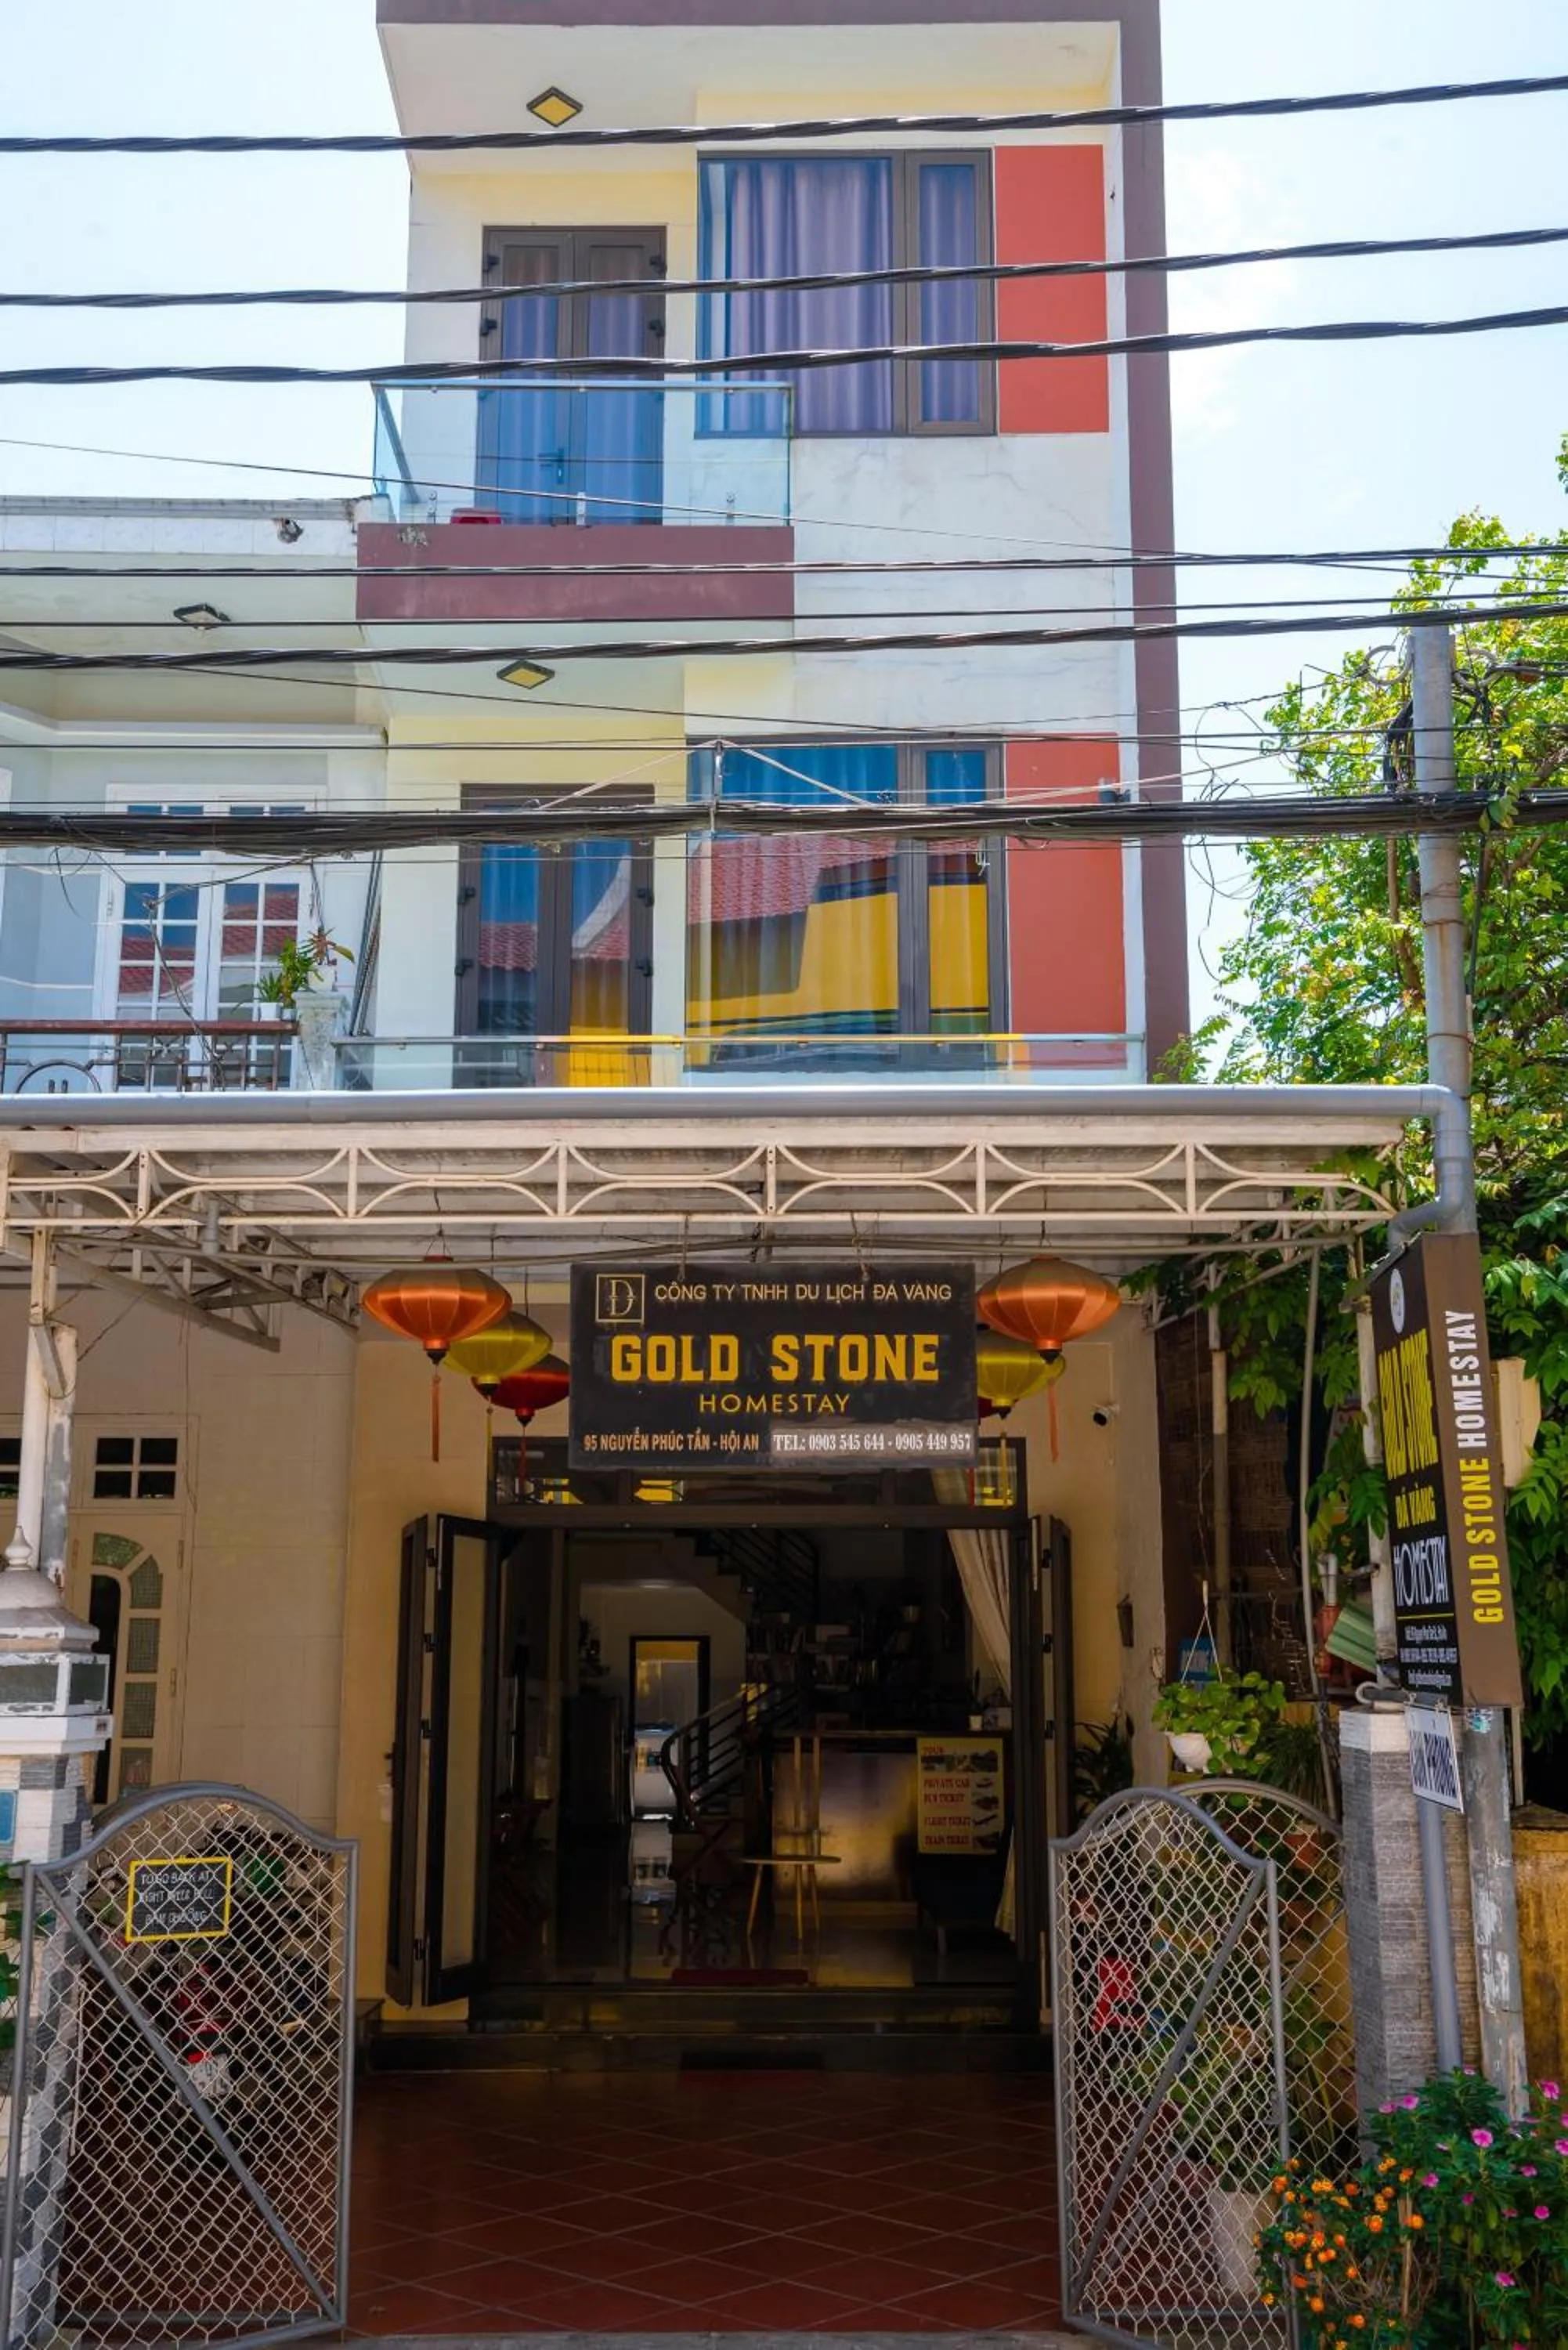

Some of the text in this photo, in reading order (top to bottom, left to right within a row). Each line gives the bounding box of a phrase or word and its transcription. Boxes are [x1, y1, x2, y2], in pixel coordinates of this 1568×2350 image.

[655, 1281, 706, 1300] CÔNG
[712, 1284, 735, 1300] TY
[741, 1284, 787, 1300] TNHH
[795, 1284, 818, 1300] DU
[826, 1284, 865, 1304] LỊCH
[611, 1335, 939, 1382] GOLD STONE
[699, 1394, 850, 1413] HOMESTAY
[583, 1434, 599, 1451] 95
[652, 1430, 684, 1452] PHÚC
[742, 1434, 759, 1452] AN
[774, 1434, 805, 1452] TEL:
[809, 1434, 836, 1452] 0903
[840, 1434, 861, 1452] 545
[864, 1434, 884, 1452] 644
[895, 1434, 923, 1451] 0905
[927, 1434, 947, 1451] 449
[950, 1434, 971, 1451] 957
[1445, 1310, 1505, 1623] GOLD STONE HOMESTAY
[139, 1890, 165, 1903] IGHT
